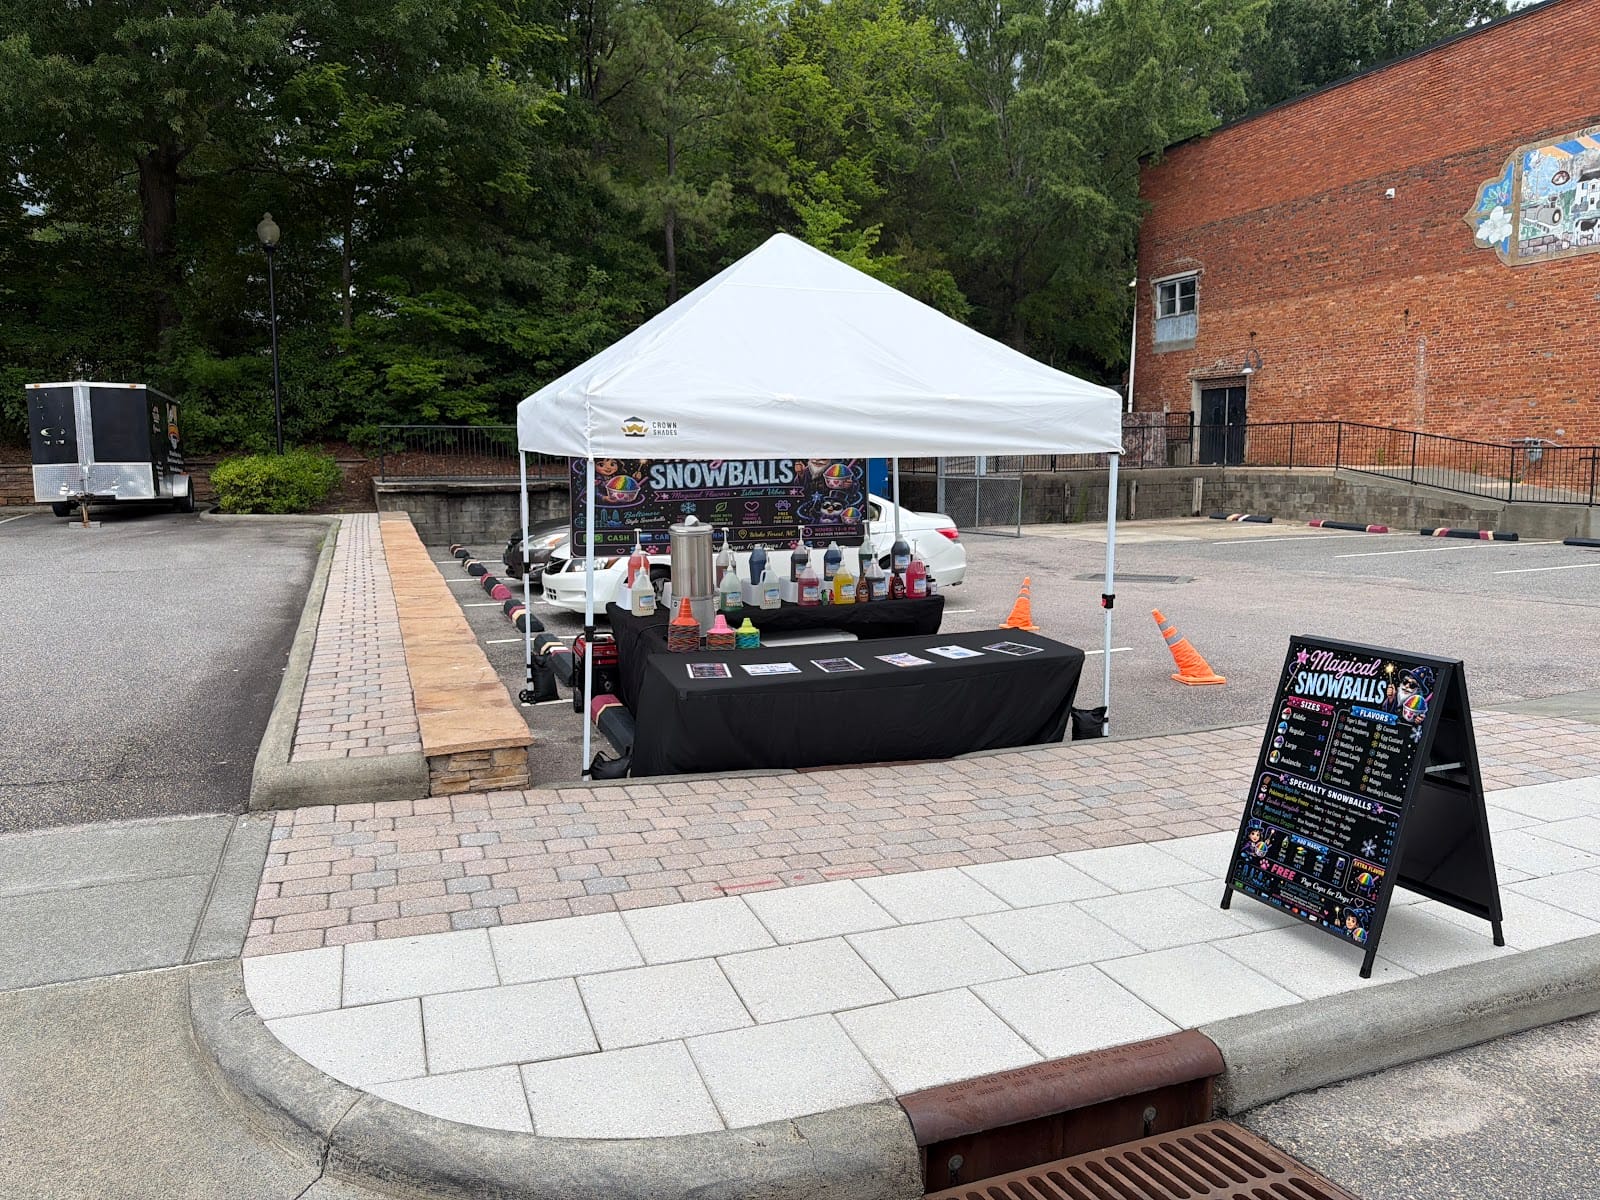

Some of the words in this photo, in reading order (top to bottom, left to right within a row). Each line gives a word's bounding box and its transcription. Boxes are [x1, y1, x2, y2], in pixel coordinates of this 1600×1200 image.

[652, 421, 677, 429] CROWN
[649, 459, 793, 490] SNOWBALLS
[623, 510, 660, 519] Baltimore
[625, 518, 640, 526] Style
[607, 534, 630, 542] CASH
[767, 530, 784, 538] Forest,
[1310, 649, 1381, 679] Magical
[1294, 671, 1387, 704] SNOWBALLS
[1300, 701, 1321, 712] SIZES
[1359, 709, 1389, 722] FLAVORS
[1288, 726, 1306, 736] Regular
[1382, 726, 1399, 735] Coconut
[1341, 733, 1354, 742] Cherry
[1380, 734, 1389, 742] Egg
[1388, 737, 1404, 745] Custard
[1284, 741, 1298, 750] Large
[1313, 749, 1321, 757] $6
[1340, 741, 1355, 751] Wedding
[1354, 744, 1364, 753] Cake
[1387, 745, 1401, 754] Colada
[1337, 750, 1350, 758] Cotton
[1349, 753, 1361, 762] Candy
[1280, 756, 1302, 768] Avalanche
[1335, 758, 1355, 770] Strawberry
[1373, 760, 1387, 769] Orange
[1371, 768, 1381, 777] Tutti
[1381, 771, 1392, 779] Frutti
[1369, 778, 1381, 786] Mango
[1288, 777, 1327, 796] SPECIALTY
[1327, 790, 1372, 811] SNOWBALLS
[1307, 841, 1322, 852] MAGIC
[1270, 863, 1296, 881] FREE
[1353, 860, 1368, 871] EXTRA
[1367, 865, 1386, 877] FLAVOR
[1300, 877, 1312, 888] Pup
[1312, 883, 1327, 894] Cups
[1326, 888, 1336, 897] for
[1335, 891, 1354, 905] Dogs!
[948, 1081, 978, 1093] DUMP
[982, 1076, 999, 1085] NO
[1051, 1056, 1093, 1069] DRAINS
